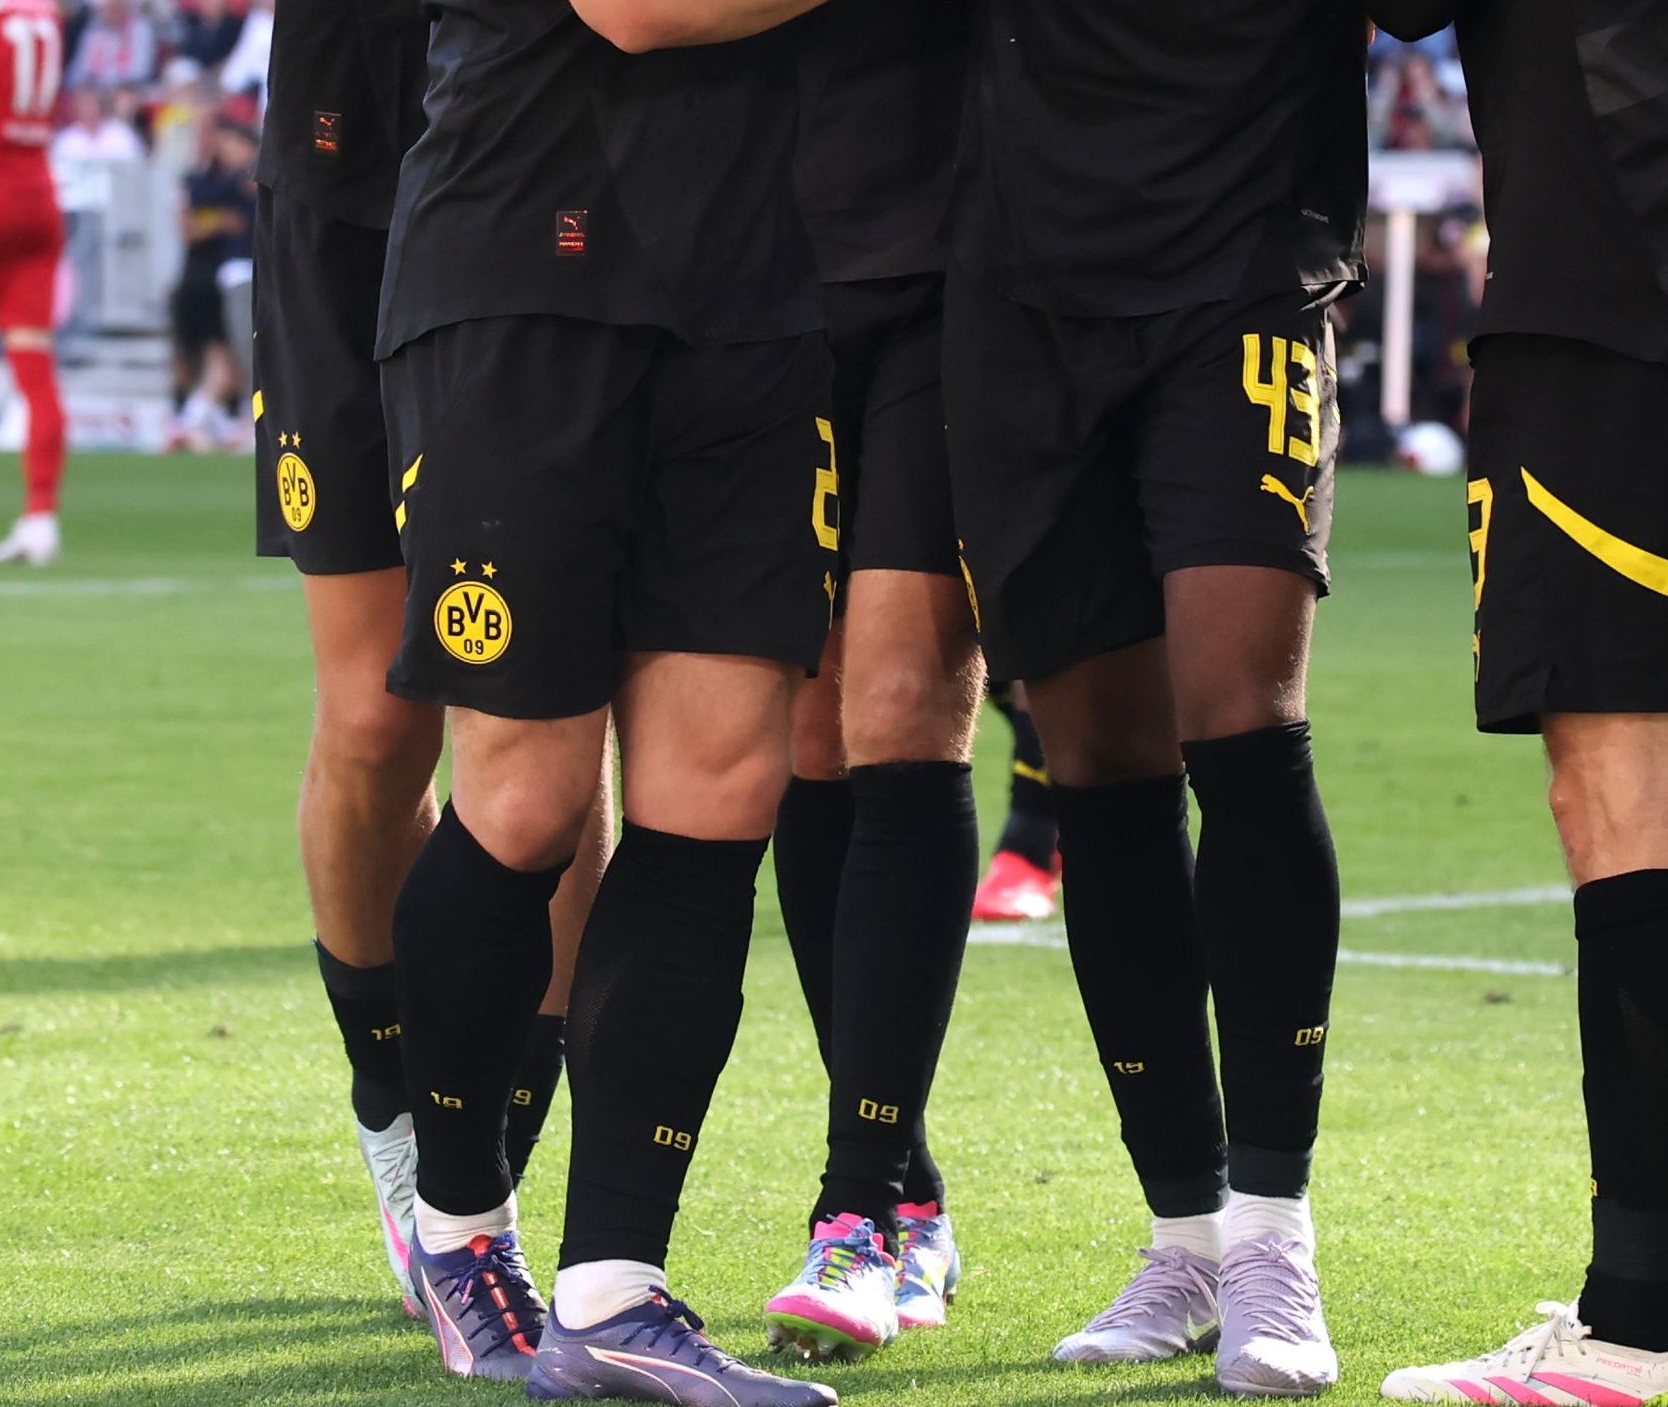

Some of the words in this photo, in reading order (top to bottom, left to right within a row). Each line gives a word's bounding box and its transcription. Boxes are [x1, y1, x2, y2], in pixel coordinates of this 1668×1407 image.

[1242, 333, 1320, 467] 43
[282, 462, 310, 507] BVB
[447, 591, 502, 641] BVB
[463, 638, 484, 656] 09
[1293, 1026, 1325, 1047] 09
[858, 1098, 899, 1124] 09
[652, 1124, 692, 1152] 09
